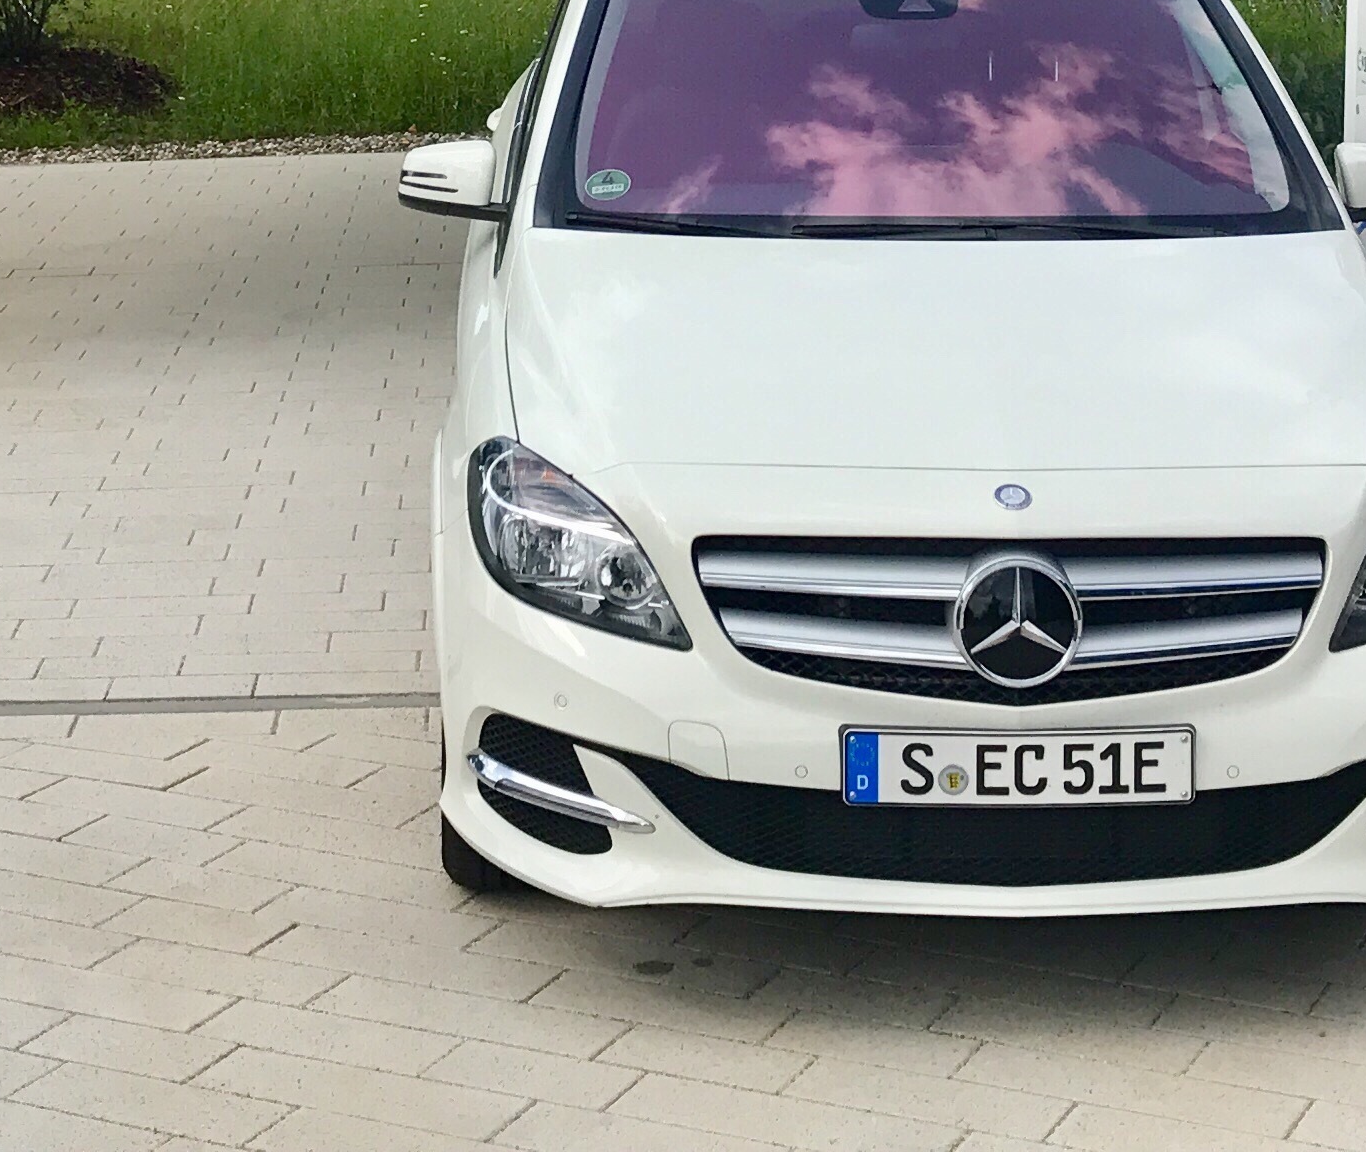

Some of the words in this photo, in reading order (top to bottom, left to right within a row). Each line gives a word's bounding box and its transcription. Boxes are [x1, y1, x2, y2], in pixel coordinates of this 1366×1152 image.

[602, 171, 614, 184] 4
[900, 742, 935, 795] S
[976, 744, 1048, 796] EC
[1063, 741, 1167, 795] 51E
[857, 774, 869, 790] D
